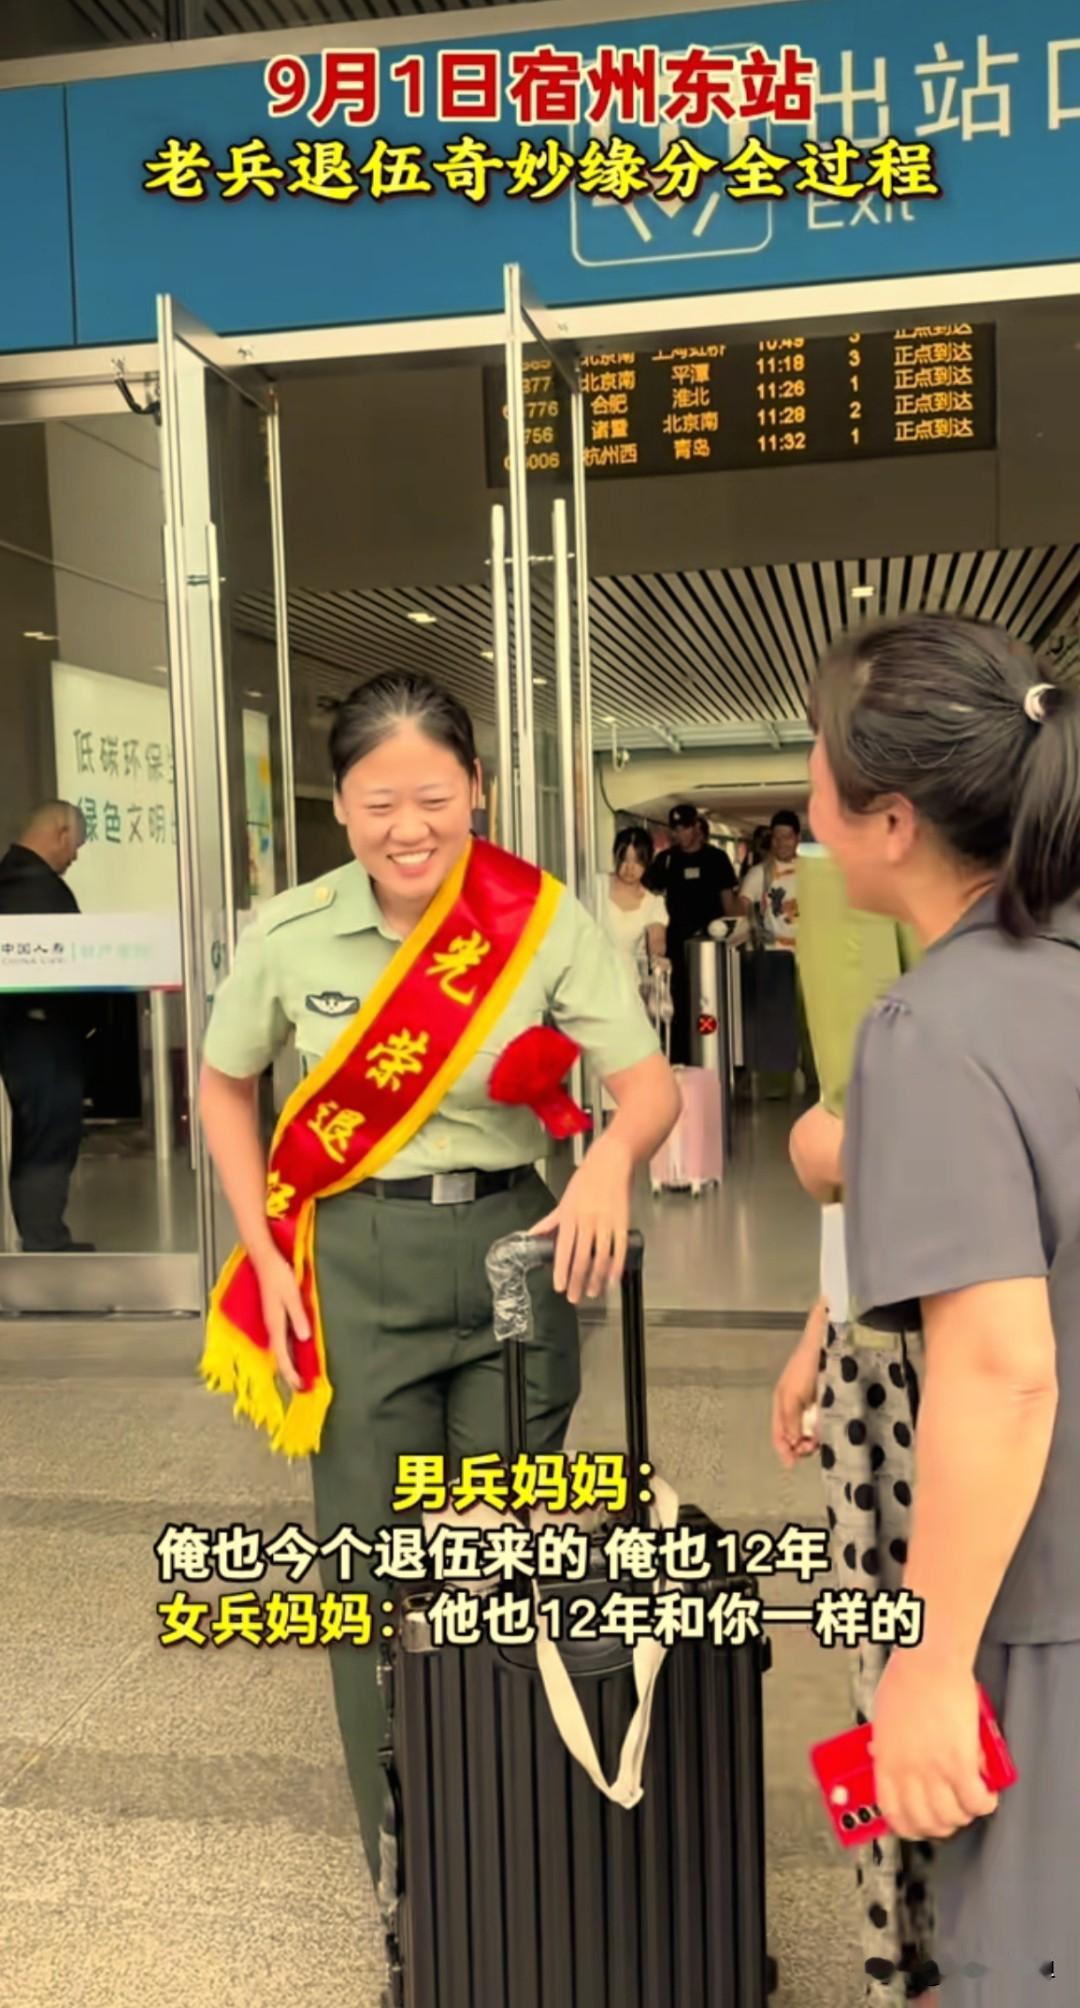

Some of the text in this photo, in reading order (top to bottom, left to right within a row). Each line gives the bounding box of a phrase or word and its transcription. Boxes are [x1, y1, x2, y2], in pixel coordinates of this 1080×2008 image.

[755, 353, 806, 375] 11:18
[848, 349, 862, 367] 3
[893, 341, 974, 366] 正点到达
[590, 393, 629, 415] 合肥
[756, 379, 806, 400] 11:26
[849, 374, 860, 392] 1
[893, 365, 974, 390] 正点到达
[661, 410, 720, 434] 北京南
[757, 405, 806, 426] 11:28
[849, 400, 862, 419] 2
[893, 390, 974, 415] 正点到达
[673, 437, 712, 460] 青岛
[757, 431, 807, 452] 11:32
[850, 426, 860, 445] 1
[894, 417, 975, 442] 正点到达
[72, 728, 174, 784] 低碳环保
[78, 796, 176, 845] 绿色文明
